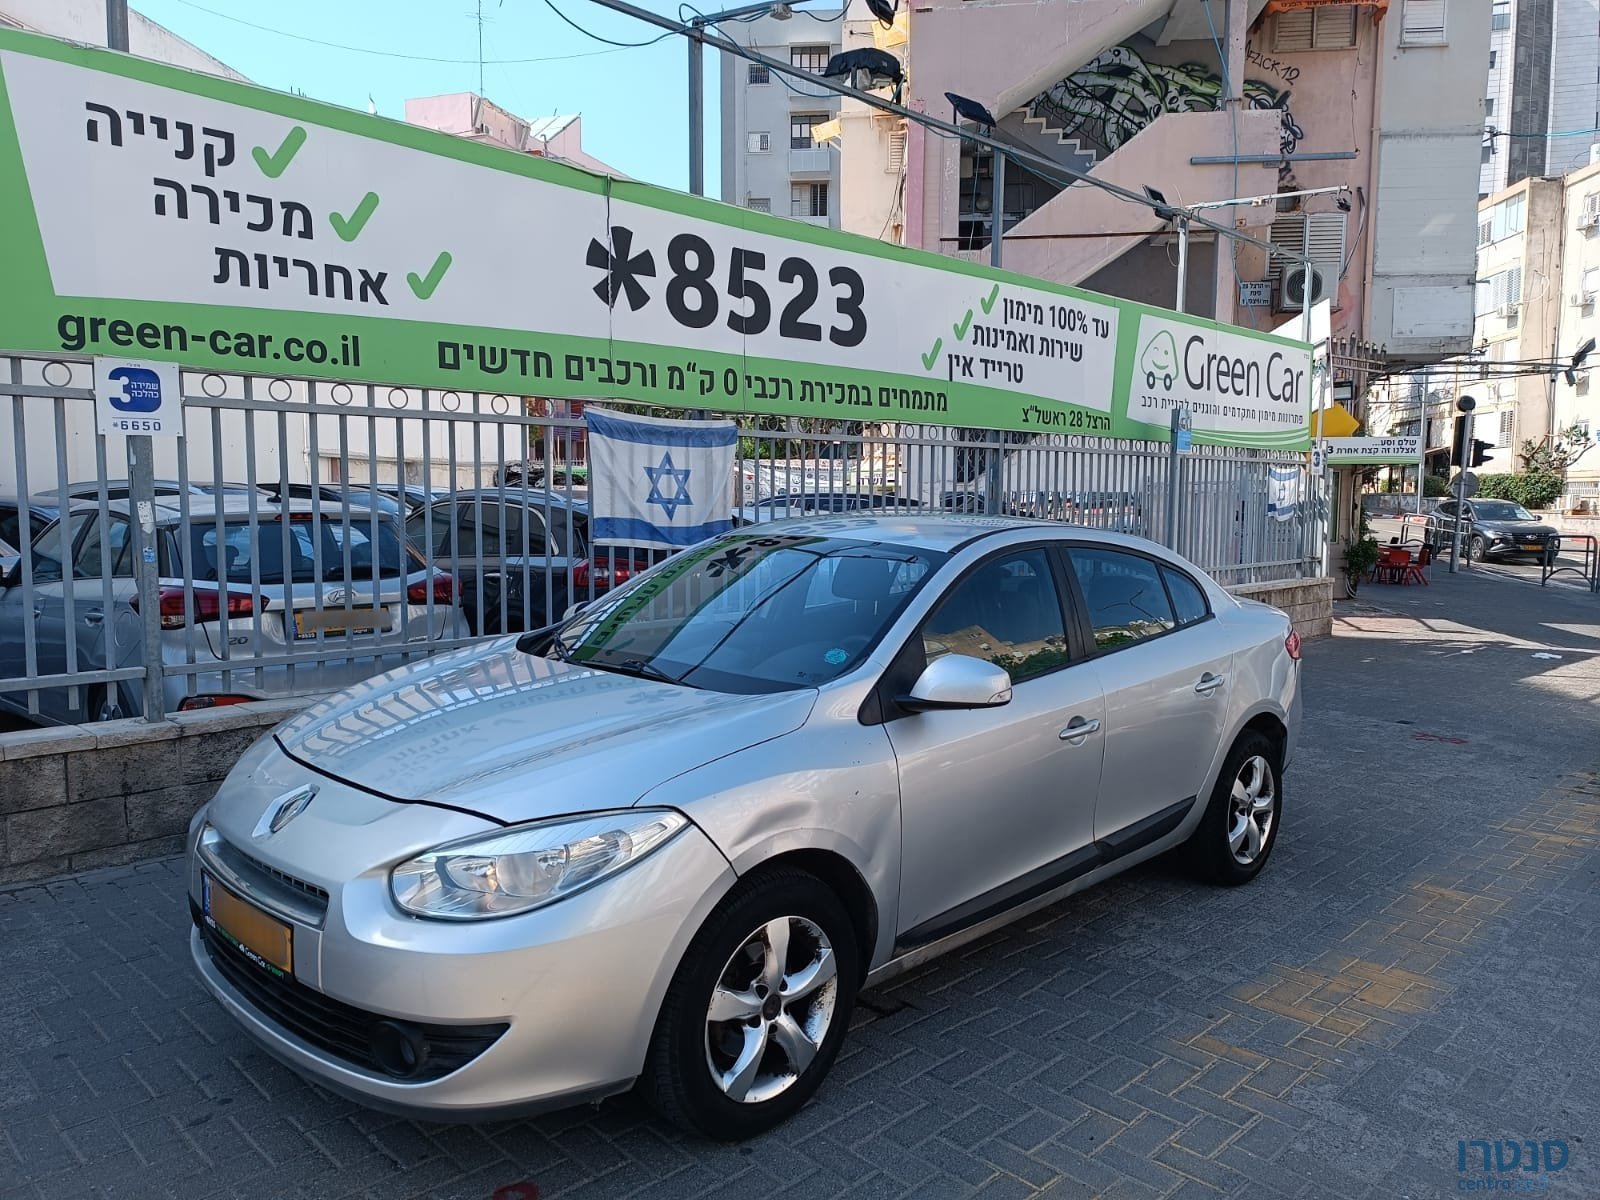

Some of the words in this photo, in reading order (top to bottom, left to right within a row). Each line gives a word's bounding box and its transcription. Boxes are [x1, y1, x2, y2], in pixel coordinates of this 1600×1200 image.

[86, 101, 235, 178] קנייה
[154, 176, 314, 240] מכירה
[213, 246, 390, 306] אחריות
[1003, 297, 1044, 325] מימון
[1049, 305, 1088, 335] 100%
[972, 322, 1036, 355] ואמינות
[1091, 316, 1110, 339] עד
[57, 314, 361, 368] green-car.co.il
[1038, 336, 1083, 362] שירות
[437, 340, 554, 380] חדשים
[564, 353, 658, 389] ורכבים
[947, 353, 974, 382] אין
[979, 357, 1024, 384] טרייד
[1183, 334, 1260, 398] Green
[1266, 351, 1304, 404] Car
[131, 381, 159, 390] שמירה
[131, 389, 160, 398] כהלכה
[744, 373, 795, 402] רכבי
[799, 379, 873, 407] במכירת
[878, 387, 949, 413] מתמחים
[1141, 395, 1158, 409] רכב
[1192, 401, 1220, 416] והוגנים
[1069, 410, 1083, 428] 28
[1086, 411, 1111, 431] הרצל
[1223, 406, 1256, 421] מתקדמים
[1258, 410, 1276, 423] מימון
[1278, 412, 1304, 425] פתרונות
[1361, 447, 1379, 456] קצת
[1393, 446, 1417, 454] אצלנו
[1397, 438, 1417, 446] שלם
